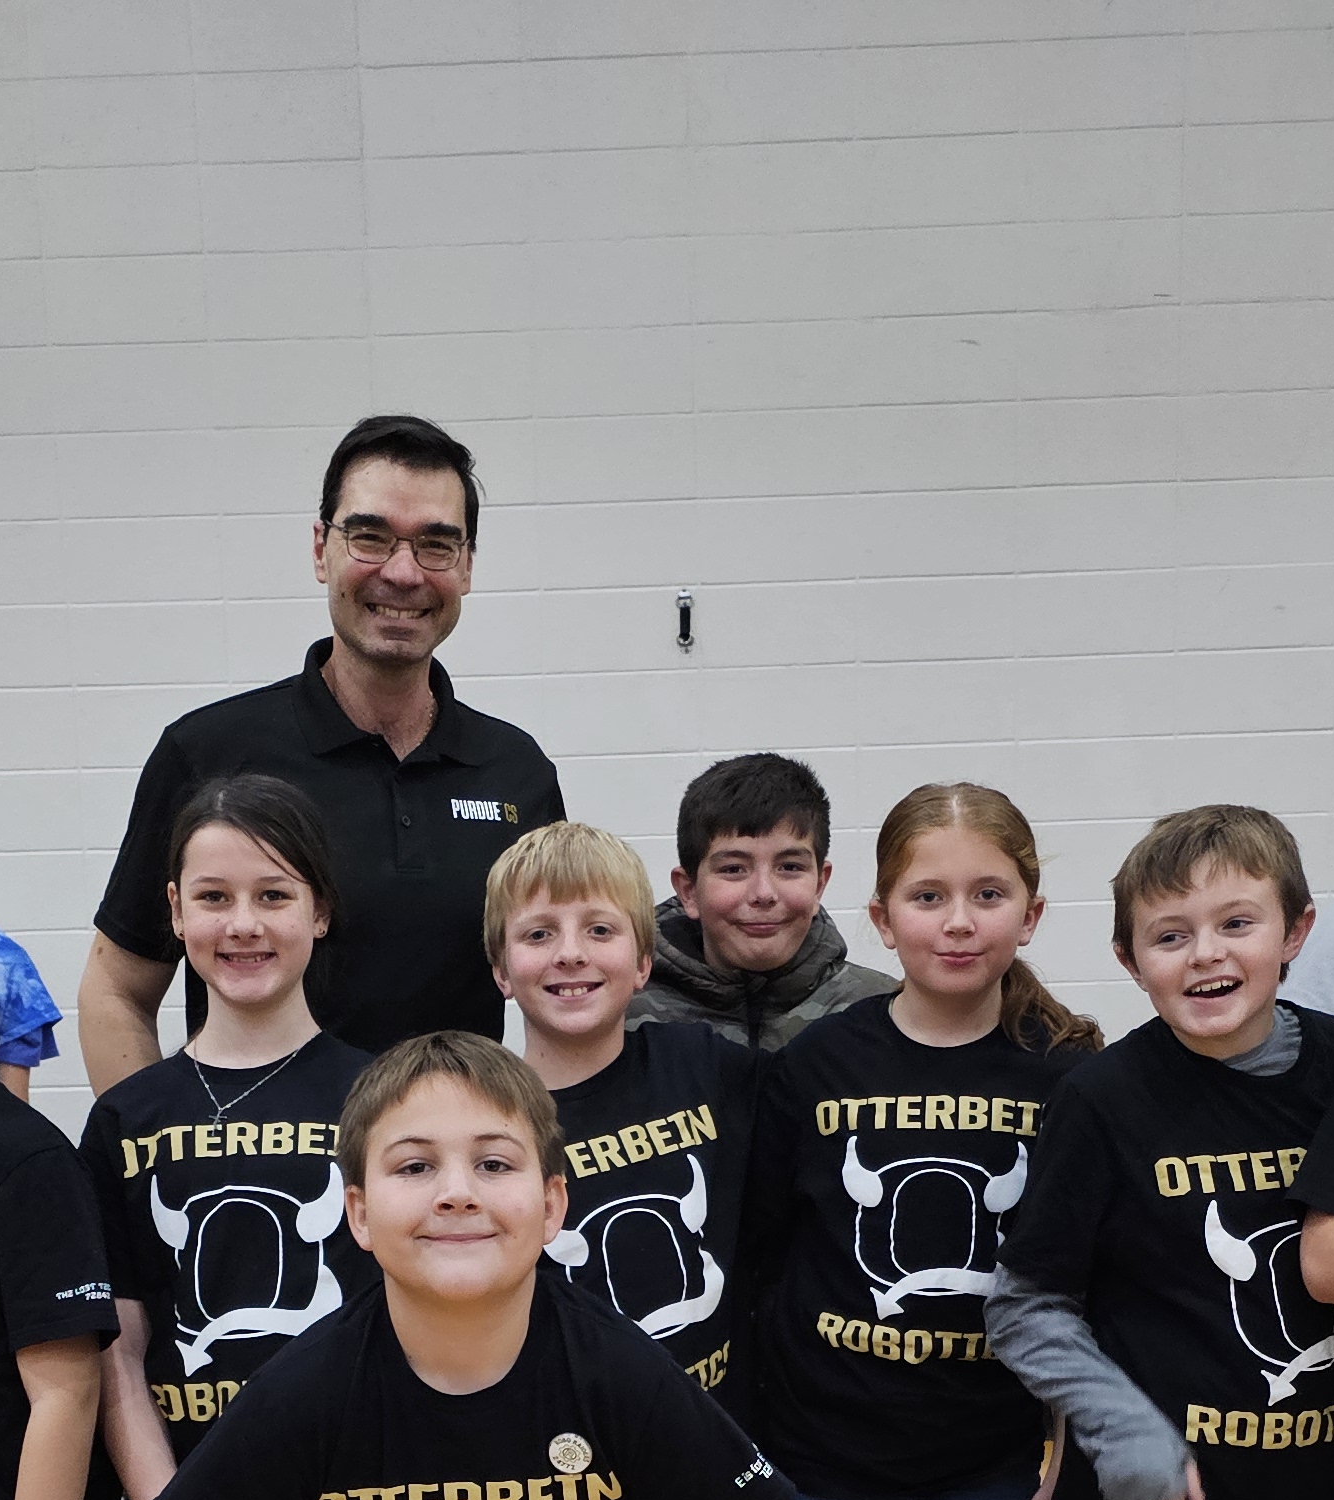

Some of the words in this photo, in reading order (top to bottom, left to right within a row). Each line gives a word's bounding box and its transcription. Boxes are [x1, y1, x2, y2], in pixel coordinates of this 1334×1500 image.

[450, 798, 502, 822] PURDUE
[504, 803, 518, 824] CS
[815, 1095, 1043, 1137] OTTERBEI
